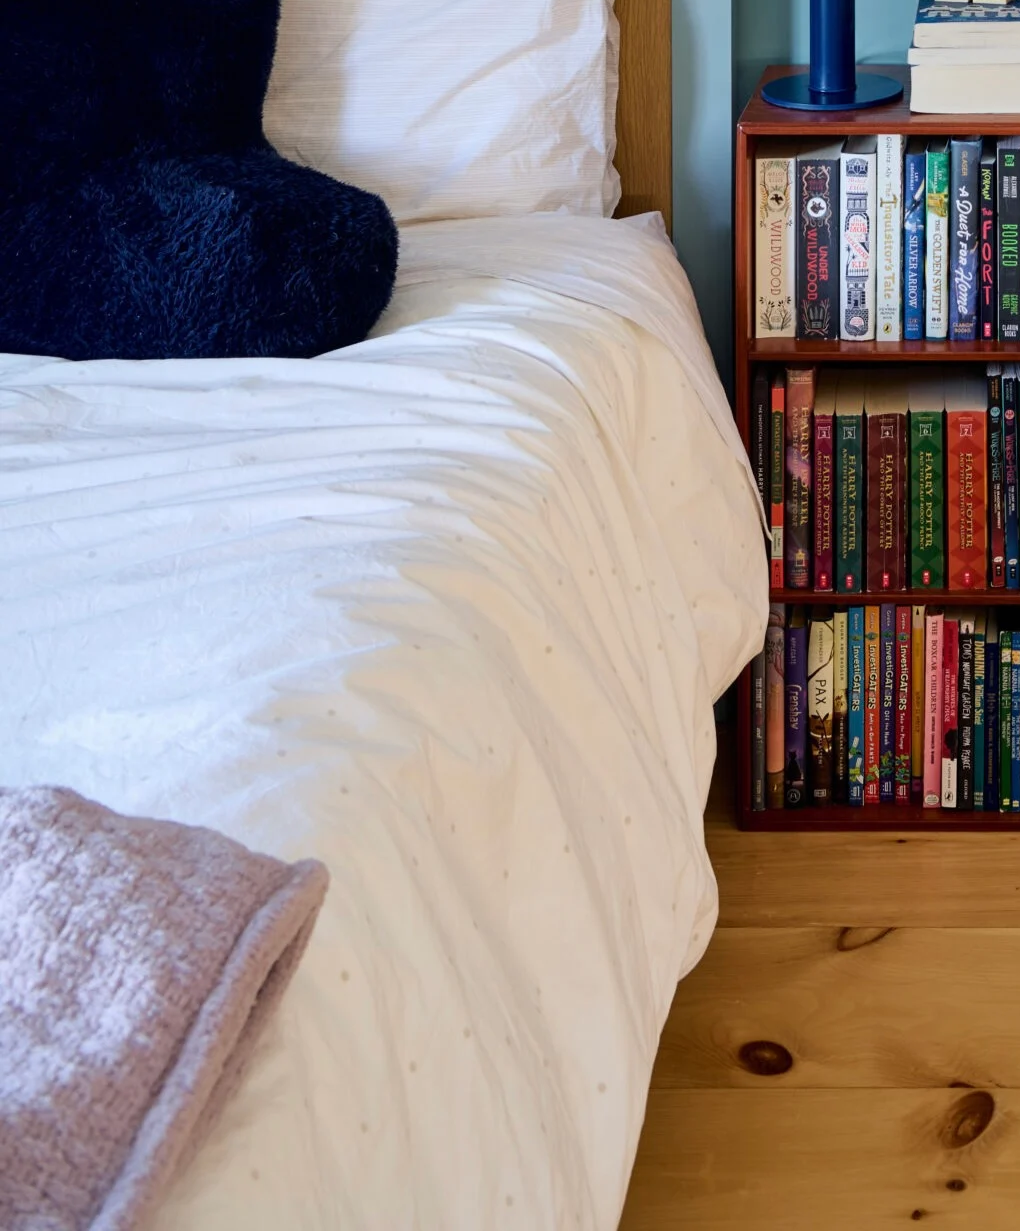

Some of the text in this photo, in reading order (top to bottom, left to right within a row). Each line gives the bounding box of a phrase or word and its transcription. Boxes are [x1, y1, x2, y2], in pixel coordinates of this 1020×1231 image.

[982, 169, 991, 200] KORMAN
[880, 194, 898, 271] Inquisitor's
[932, 233, 941, 276] GOLDEN
[955, 186, 974, 315] A Duet FOR Home
[1002, 224, 1018, 266] BOOKED
[771, 220, 782, 295] WILDWOOD
[807, 228, 817, 300] WILDWOOD
[819, 246, 828, 280] UNDER
[909, 236, 917, 308] SILVER ARROW
[884, 273, 895, 299] Tale
[932, 278, 941, 313] SWIFT
[1002, 294, 1010, 309] NOVEL
[1010, 294, 1018, 315] GRAPHIC
[800, 407, 808, 525] HARRY POTTER
[924, 452, 933, 497] HARRY
[965, 453, 973, 497] HARRY
[822, 455, 830, 550] HARRY POTTER
[848, 455, 856, 551] HARRY POTTER
[885, 454, 893, 549] HARRY POTTER
[974, 641, 984, 680] DOMINIC
[788, 685, 802, 729] Crenshaw
[816, 680, 826, 705] PAX
[975, 685, 984, 707] William
